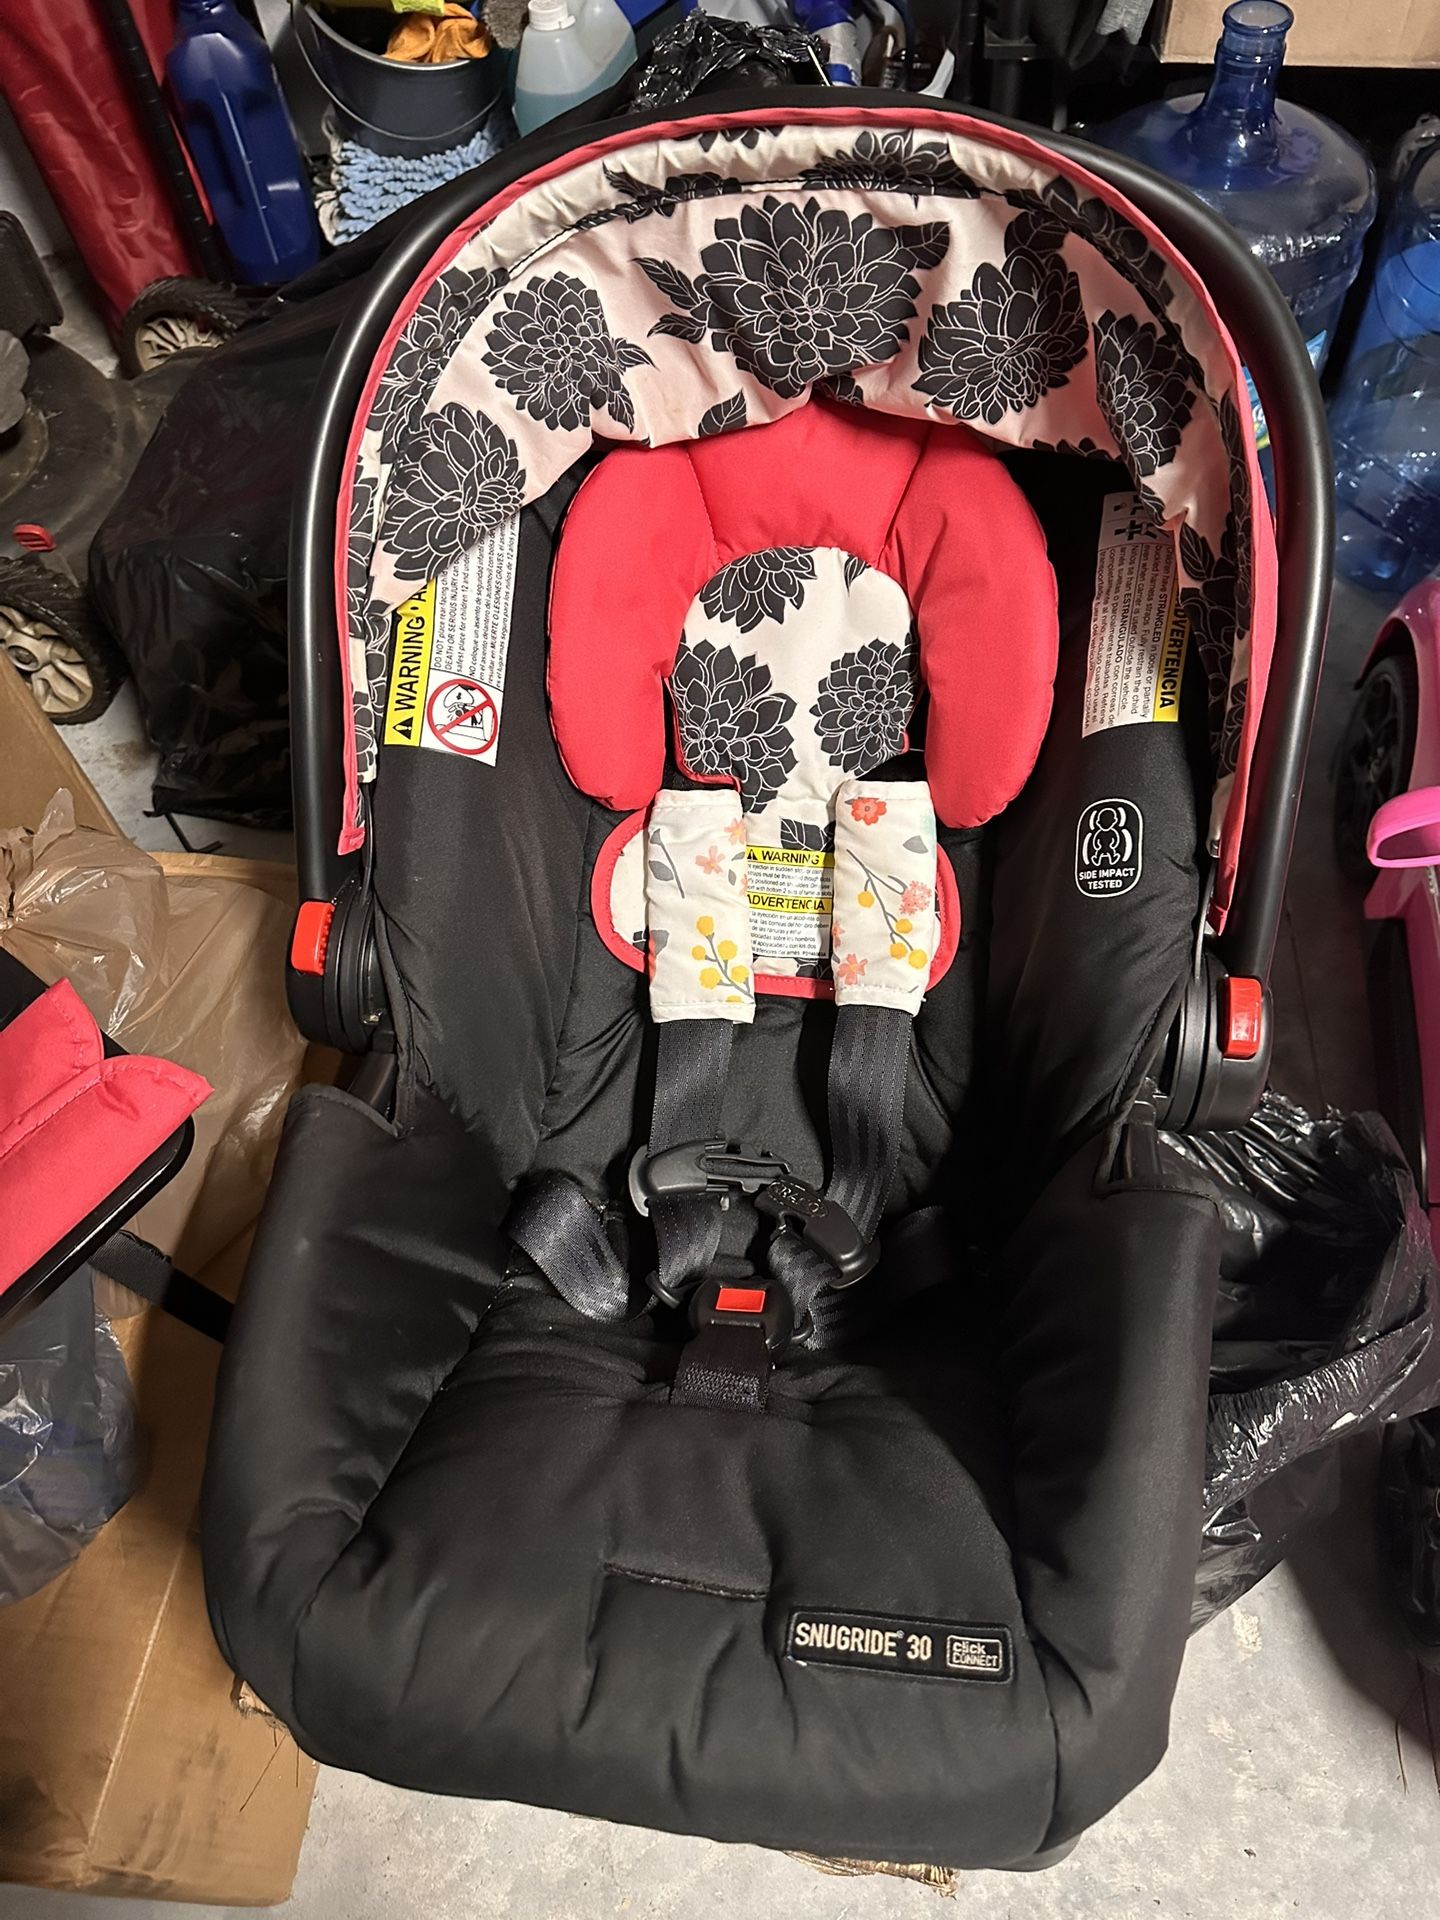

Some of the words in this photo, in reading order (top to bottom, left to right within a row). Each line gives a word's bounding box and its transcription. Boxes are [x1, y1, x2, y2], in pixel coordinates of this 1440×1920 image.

[450, 579, 458, 601] INJURY
[476, 566, 484, 595] seguridad
[474, 597, 479, 605] de
[493, 581, 501, 613] LESIONES
[448, 602, 457, 632] SERIOUS
[1115, 593, 1133, 663] ESTRANGULADO
[1152, 594, 1168, 642] STRANGLED
[448, 634, 454, 644] OR
[474, 630, 478, 638] un
[490, 621, 499, 649] MUERTE
[500, 618, 508, 640] seguro
[434, 657, 442, 668] DO
[438, 622, 446, 638] place
[471, 640, 479, 665] coloque
[479, 672, 484, 680] en
[482, 610, 490, 639] delantero
[490, 650, 495, 658] en
[394, 616, 425, 711] WARNING
[445, 646, 453, 670] DEATH
[1135, 649, 1145, 678] restrain
[1147, 653, 1157, 674] loose
[469, 666, 476, 676] NO
[1113, 665, 1122, 680] con
[1124, 667, 1132, 679] the
[1145, 676, 1153, 684] or
[1110, 682, 1119, 713] correas
[1133, 680, 1141, 693] the
[1130, 695, 1139, 714] child
[1140, 687, 1151, 718] partially
[761, 850, 819, 865] WARNING
[1079, 870, 1097, 880] SIDE
[1099, 868, 1135, 878] IMPACT
[1088, 879, 1123, 890] TESTED
[906, 1634, 932, 1661] 30
[952, 1653, 998, 1667] CONNECT
